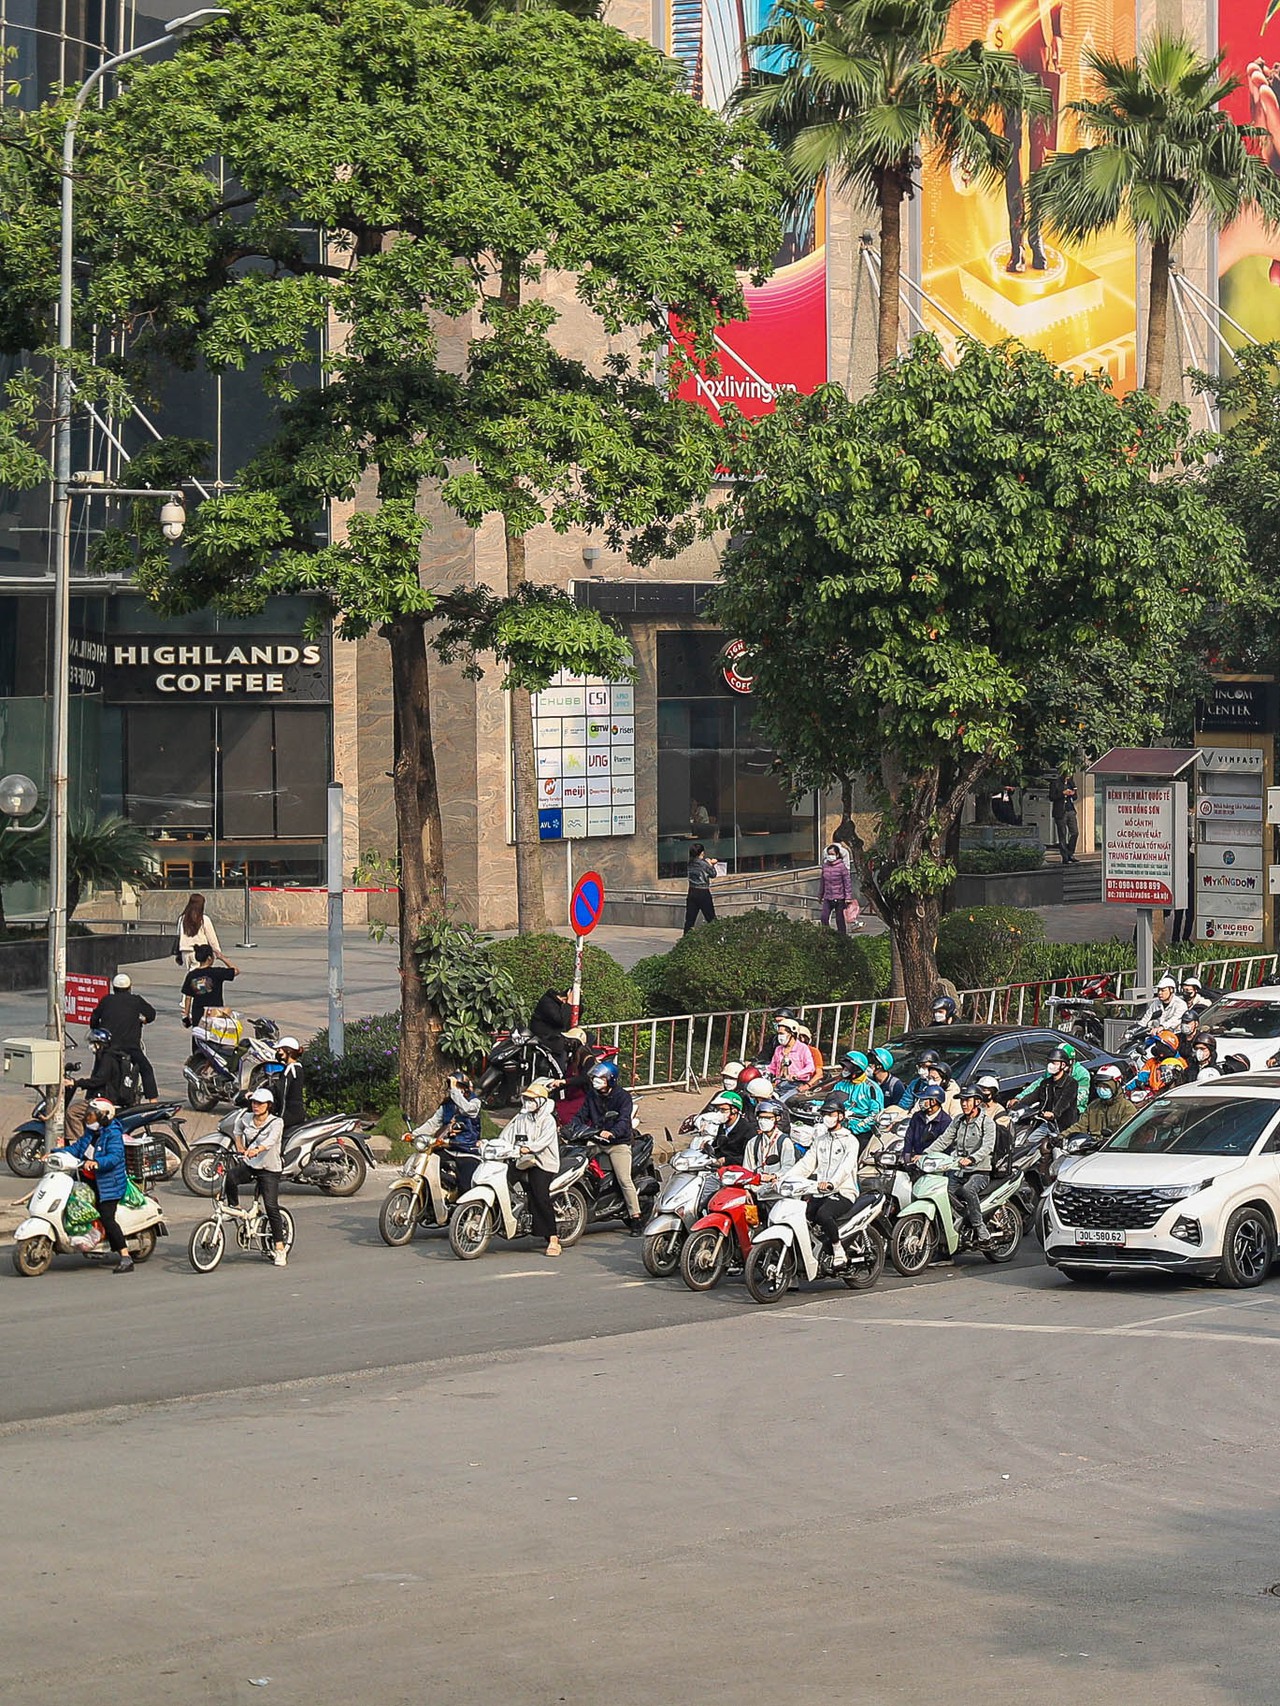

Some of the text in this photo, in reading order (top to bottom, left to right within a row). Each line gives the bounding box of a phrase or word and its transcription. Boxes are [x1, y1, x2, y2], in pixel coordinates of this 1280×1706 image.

[114, 646, 320, 665] HIGHLANDS
[156, 673, 284, 692] COFFEE
[589, 692, 607, 705] CSI
[1210, 689, 1253, 700] INCOM
[540, 697, 580, 705] CHUBB
[1208, 704, 1250, 716] CENTER
[1218, 756, 1260, 764] VINFAST
[564, 786, 585, 798] meiji
[1203, 875, 1255, 889] MYKINGDOM
